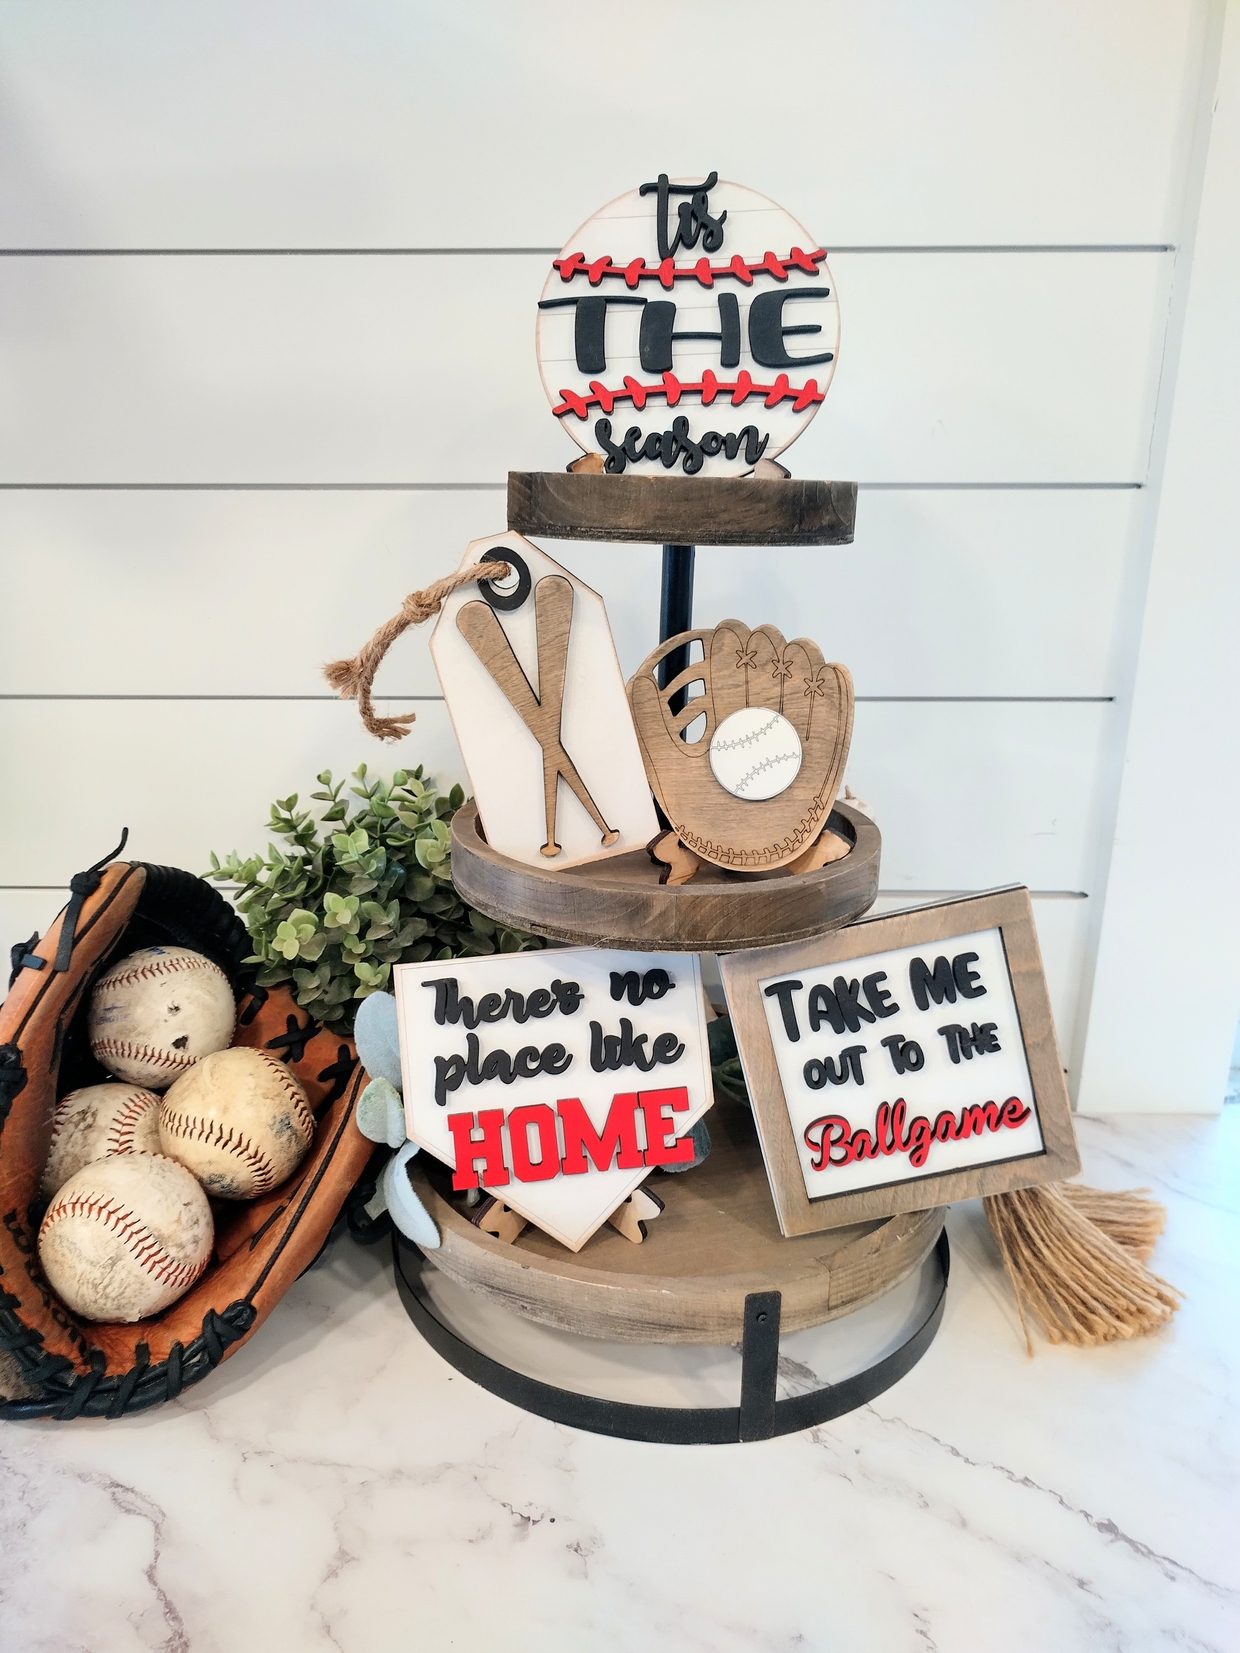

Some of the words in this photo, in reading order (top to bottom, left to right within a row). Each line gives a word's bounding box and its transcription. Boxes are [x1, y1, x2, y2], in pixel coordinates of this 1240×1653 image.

[538, 287, 834, 375] THE
[595, 415, 770, 475] season
[609, 968, 676, 1007] no
[764, 970, 900, 1043] TAKE
[909, 951, 987, 1012] ME
[434, 1032, 573, 1106] place
[589, 1017, 686, 1073] like
[803, 1044, 867, 1089] OUT
[937, 1021, 1002, 1065] THE
[447, 1085, 696, 1192] HOME
[804, 1095, 1032, 1172] Ballgame
